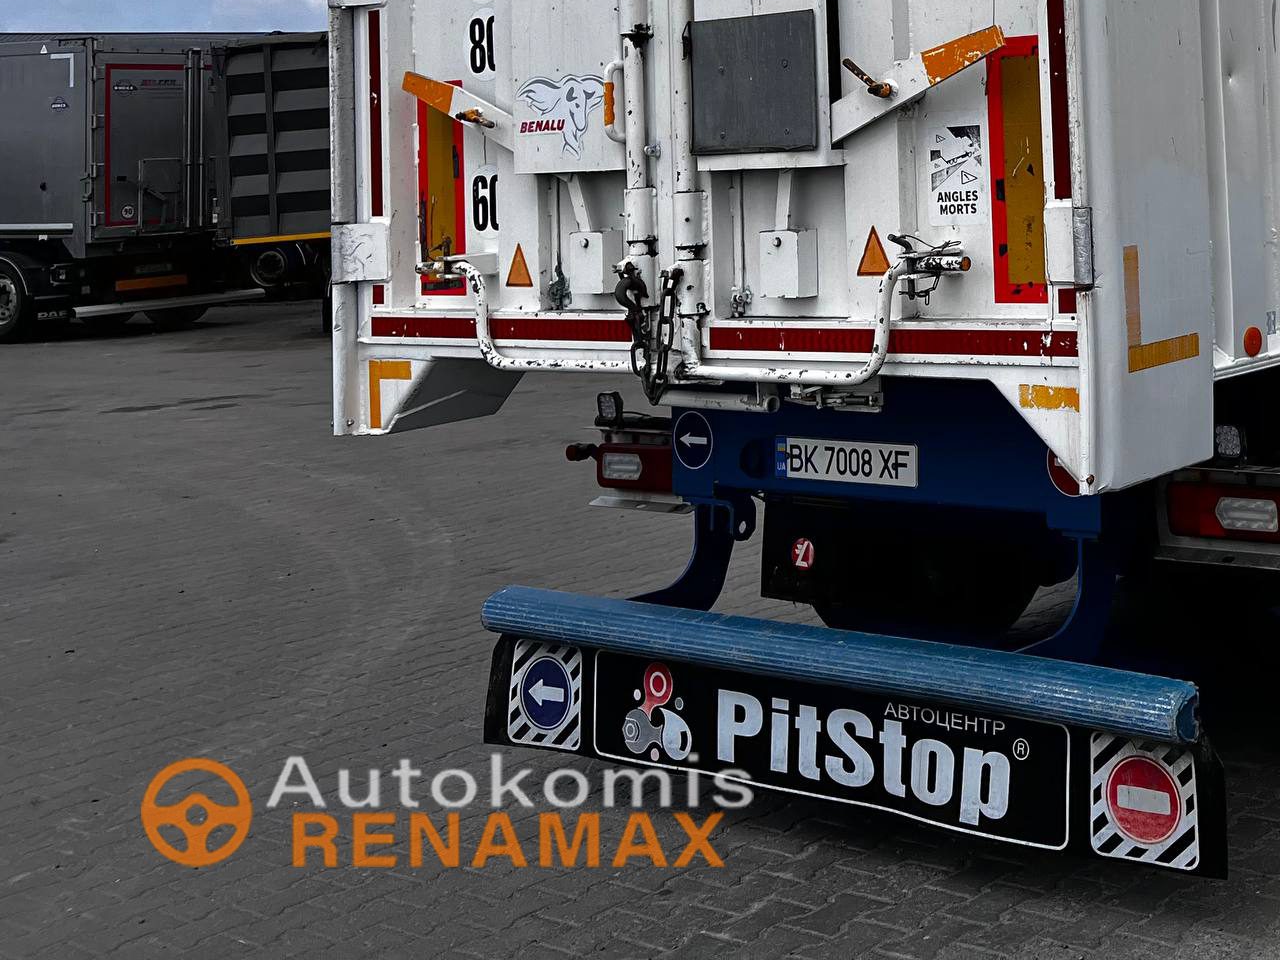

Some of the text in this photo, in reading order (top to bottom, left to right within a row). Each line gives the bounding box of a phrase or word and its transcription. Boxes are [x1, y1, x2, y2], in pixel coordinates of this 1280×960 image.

[520, 119, 565, 134] BENALU
[937, 191, 979, 203] ANGLES
[939, 203, 977, 215] MORTS
[776, 461, 786, 471] UA
[789, 444, 910, 480] BK 7008 XF
[884, 701, 1006, 736] АВТОЦЕНТР
